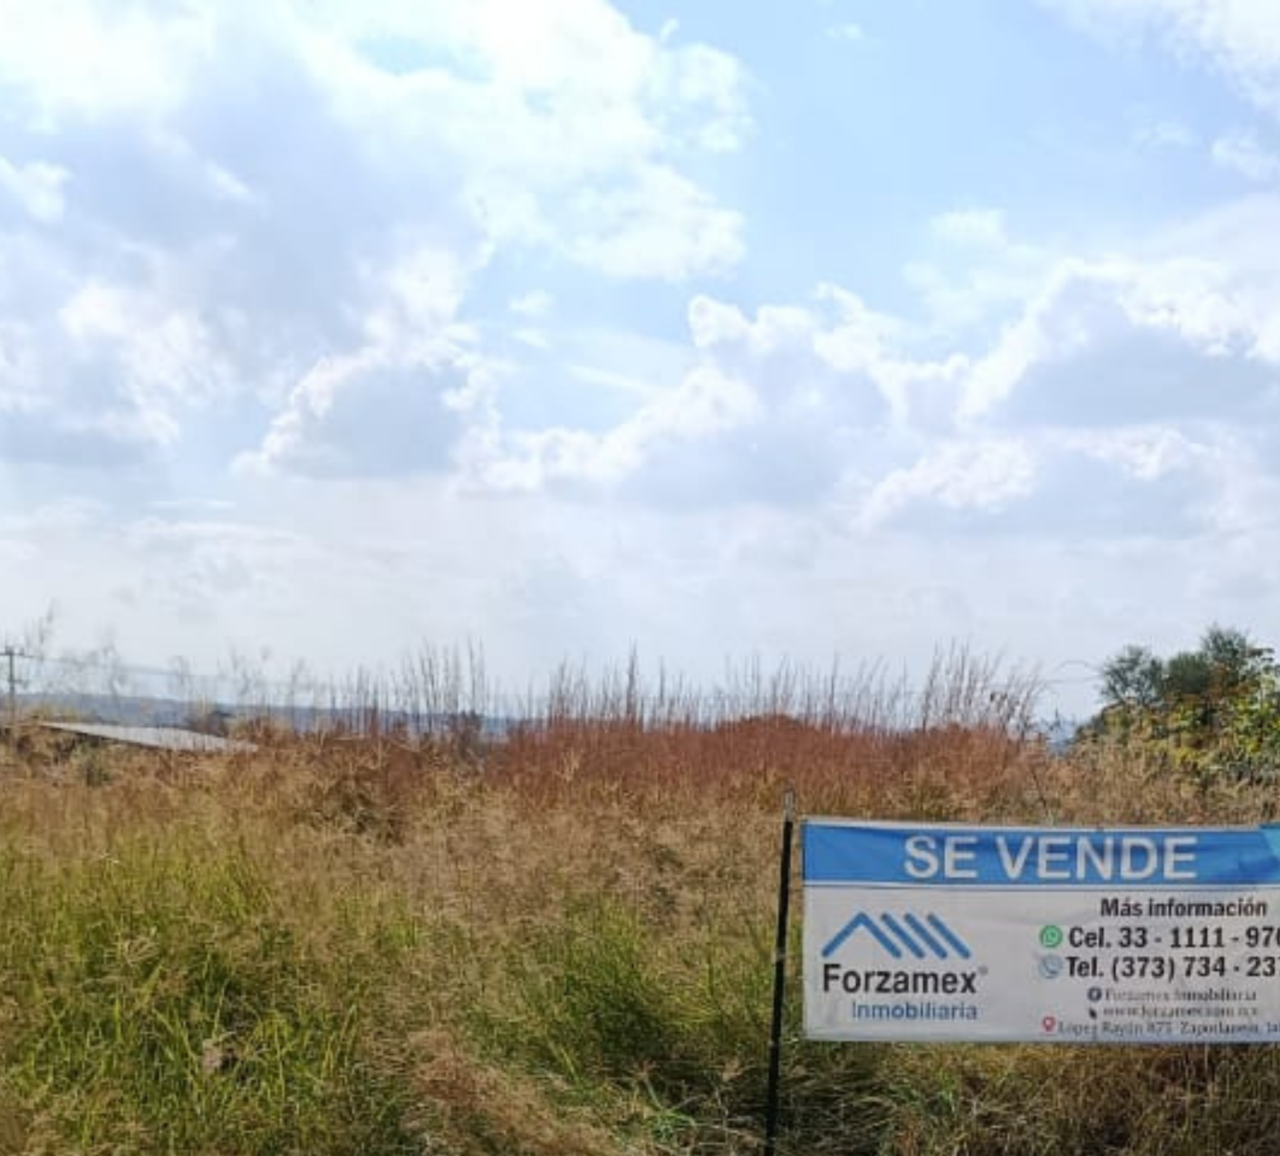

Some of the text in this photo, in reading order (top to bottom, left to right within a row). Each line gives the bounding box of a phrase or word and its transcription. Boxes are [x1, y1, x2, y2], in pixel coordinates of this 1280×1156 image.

[904, 836, 1199, 880] SE VENDE
[1100, 896, 1267, 917] Más información
[1069, 926, 1112, 948] Cel.
[1118, 926, 1148, 948] 33
[1169, 926, 1225, 948] 1111
[822, 964, 978, 995] Forzamex
[1066, 956, 1104, 977] Tel.
[1111, 956, 1175, 982] (373)
[1184, 956, 1226, 977] 734
[852, 1002, 978, 1020] Inmobiliaria
